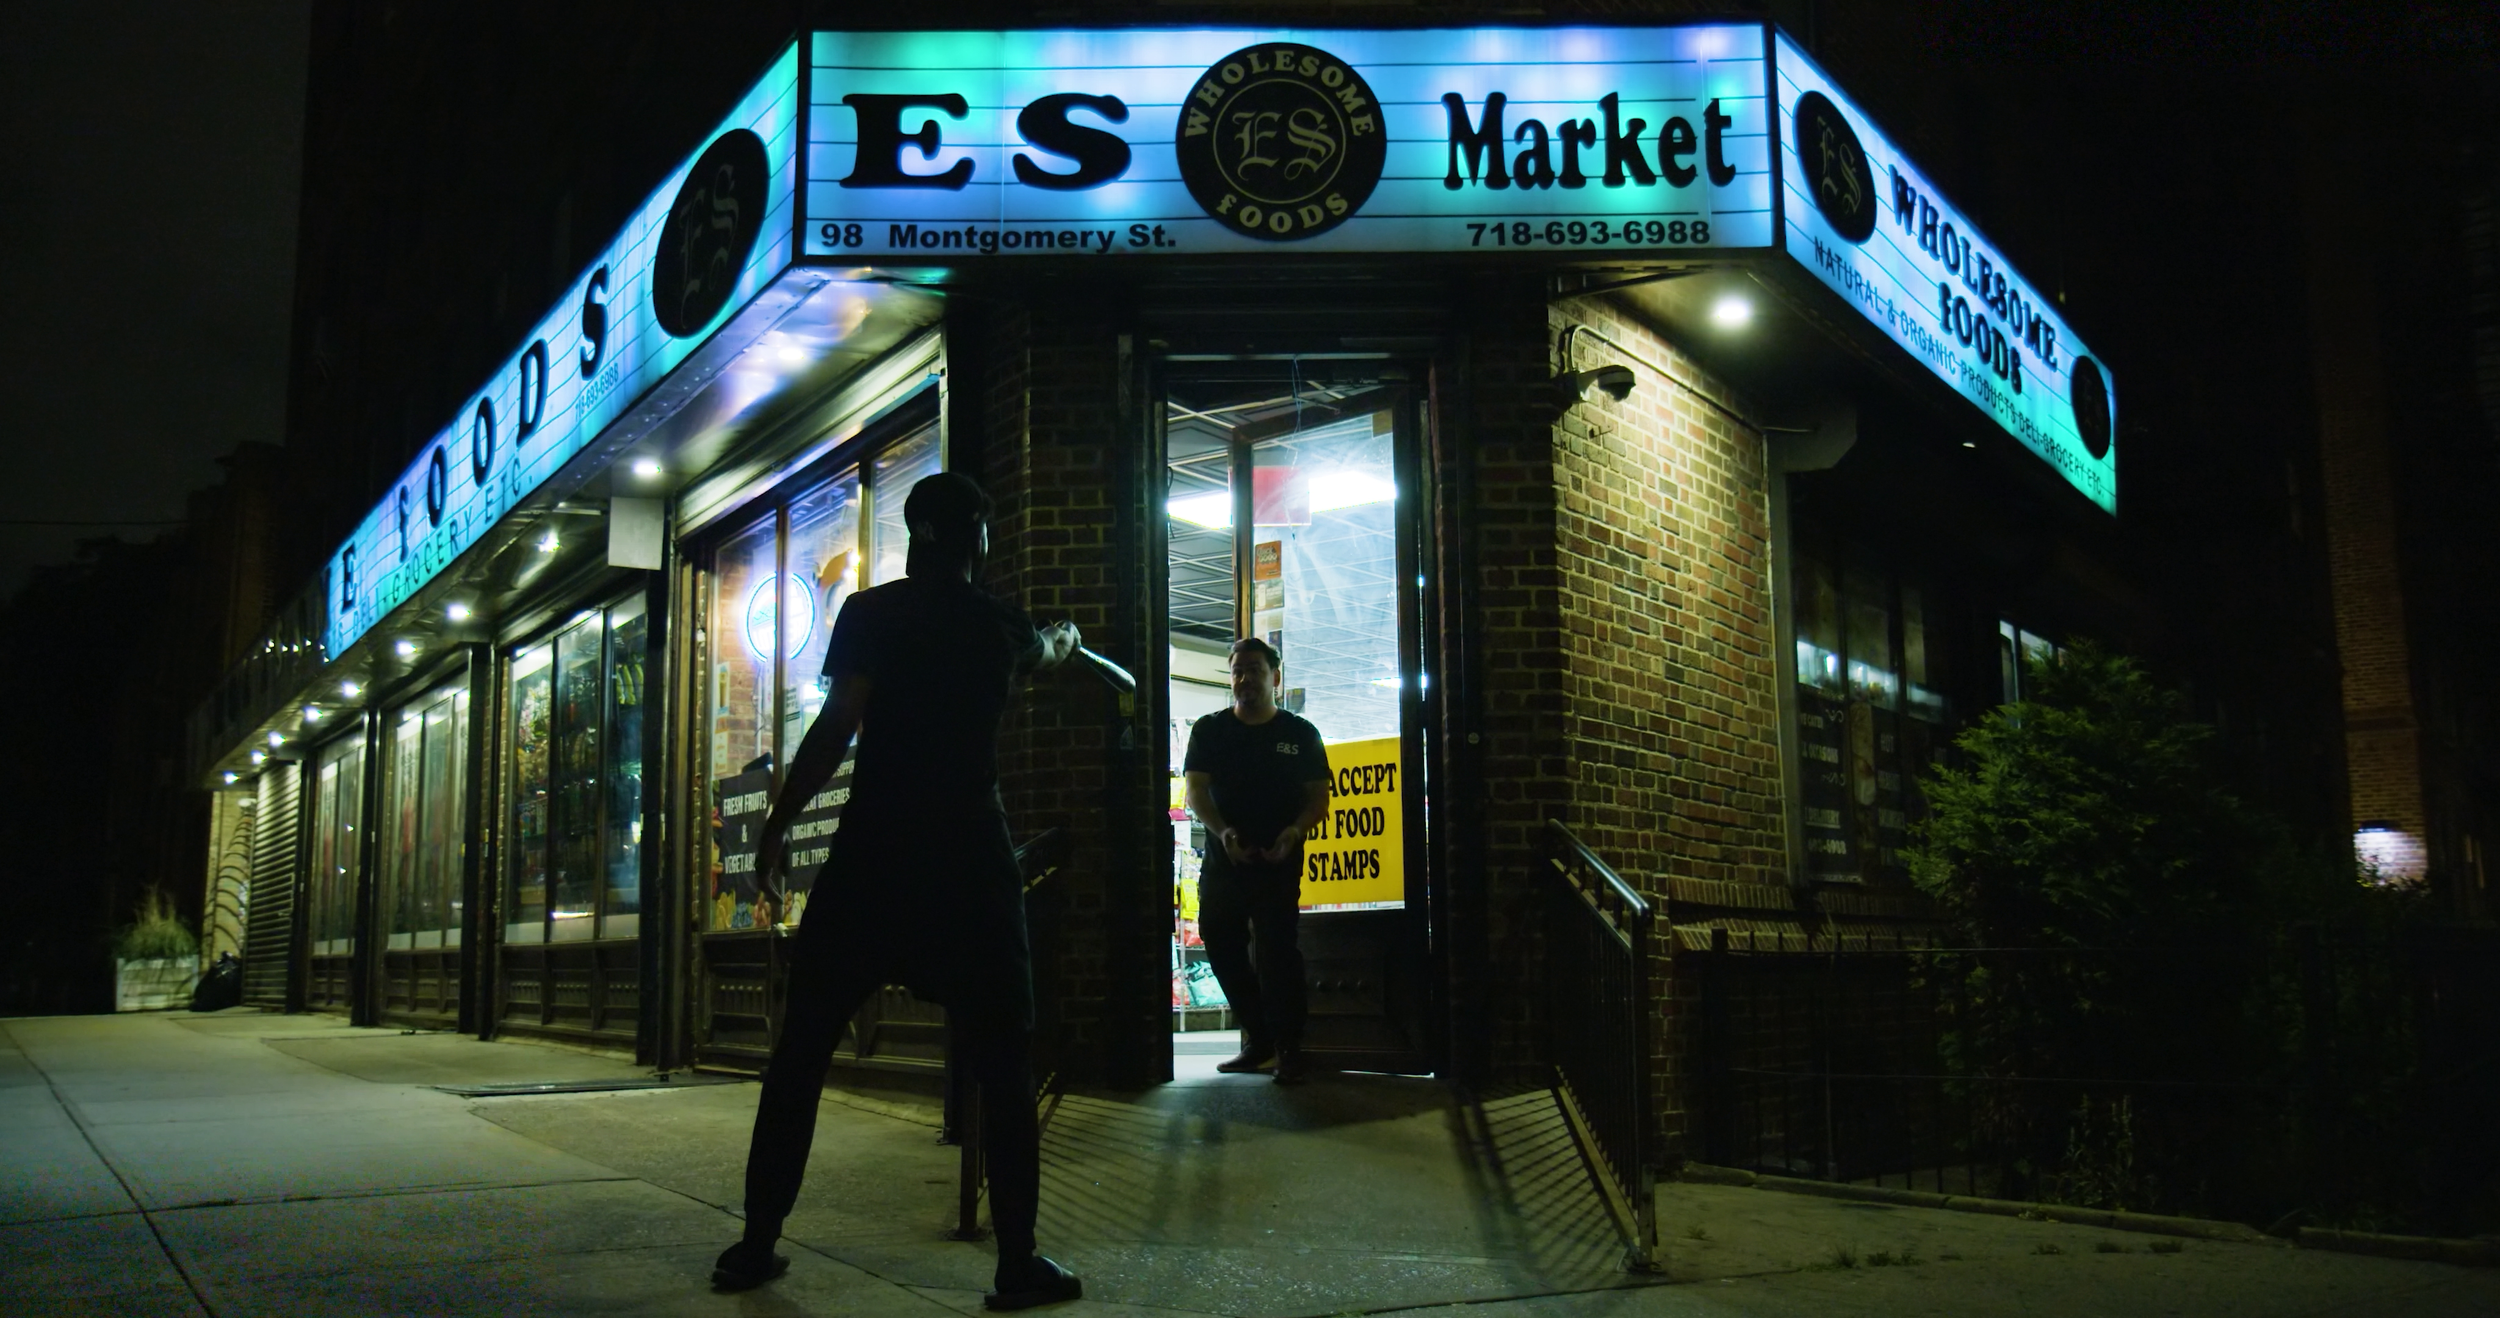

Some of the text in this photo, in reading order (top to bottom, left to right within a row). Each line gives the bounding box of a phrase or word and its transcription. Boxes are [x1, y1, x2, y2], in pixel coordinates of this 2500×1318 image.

[1184, 49, 1376, 138] WHOLESOME
[1231, 107, 1337, 181] ES
[1441, 92, 1737, 191] Market
[820, 223, 1177, 254] 98 Montgomery St.
[1466, 220, 1711, 246] 718-693-6988
[1888, 163, 2059, 372] WHOLESOME
[1815, 236, 1883, 316] NATURAL
[1887, 298, 1896, 327] &
[1900, 310, 1956, 375] ORGANIC
[1960, 359, 2016, 425] PRODUCTS
[574, 362, 619, 422] 718-693-6988
[1276, 742, 1299, 755] E&S
[1328, 762, 1397, 798] ACCEPT
[723, 790, 768, 817] FRESH FRUITS
[818, 786, 850, 809] GROCERIES
[741, 823, 748, 844] &
[792, 821, 817, 841] ORGANIC
[1335, 806, 1385, 839] FOOD
[724, 852, 757, 875] VEGETABL
[792, 847, 830, 868] OF ALL TYPES
[1308, 848, 1380, 882] STAMPS
